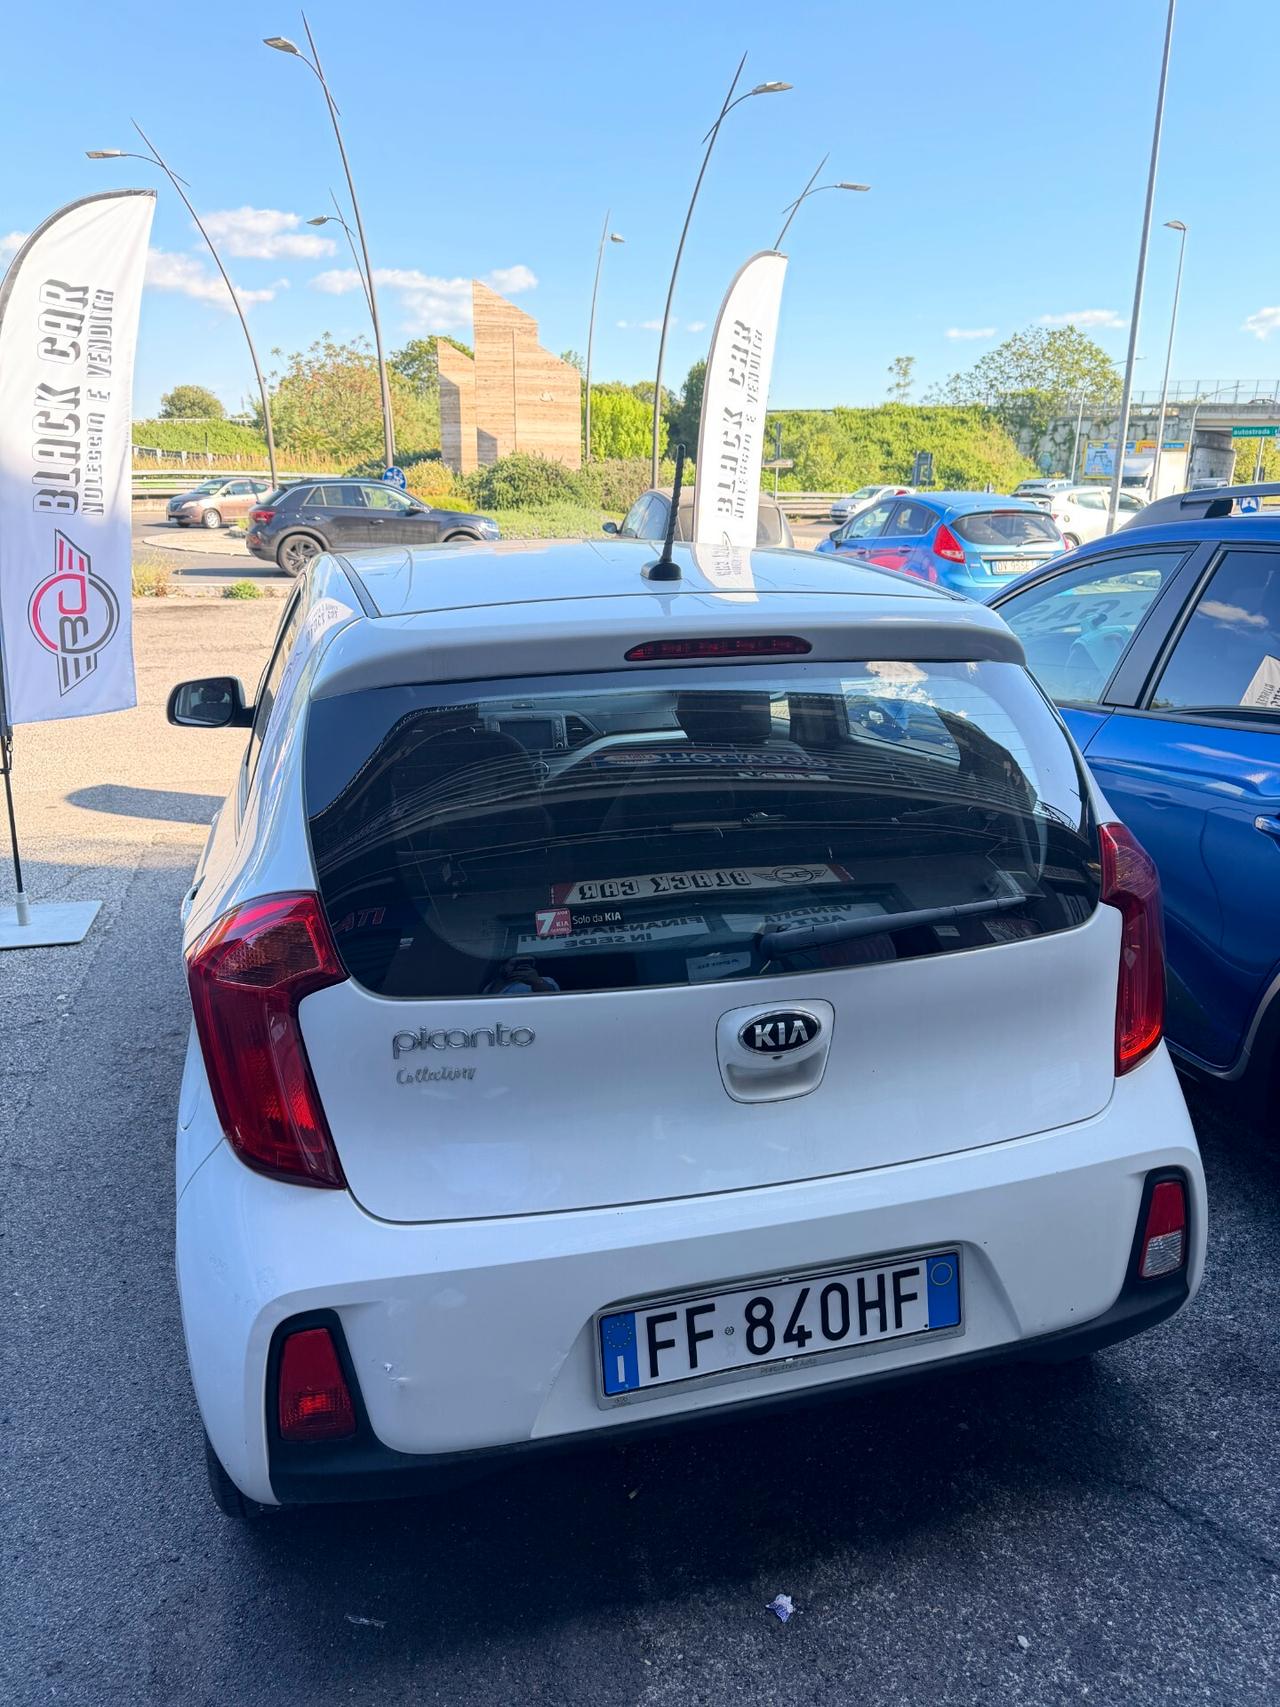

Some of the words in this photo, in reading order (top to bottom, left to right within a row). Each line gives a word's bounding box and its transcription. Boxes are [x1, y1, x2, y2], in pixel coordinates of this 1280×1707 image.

[38, 279, 89, 364] CAR
[87, 289, 115, 378] VENDITA
[727, 319, 752, 388] CAR
[88, 391, 112, 403] E
[1233, 427, 1270, 437] autostrada
[32, 383, 81, 515] BLACK
[82, 413, 106, 516] NOLEGGIO
[716, 407, 743, 517] BLACK
[572, 914, 591, 925] Solo
[593, 913, 603, 923] da
[604, 911, 622, 922] KIA
[392, 1022, 536, 1060] picanto
[753, 1019, 809, 1048] KIA
[646, 1303, 716, 1378] FF
[744, 1266, 921, 1356] 840HF
